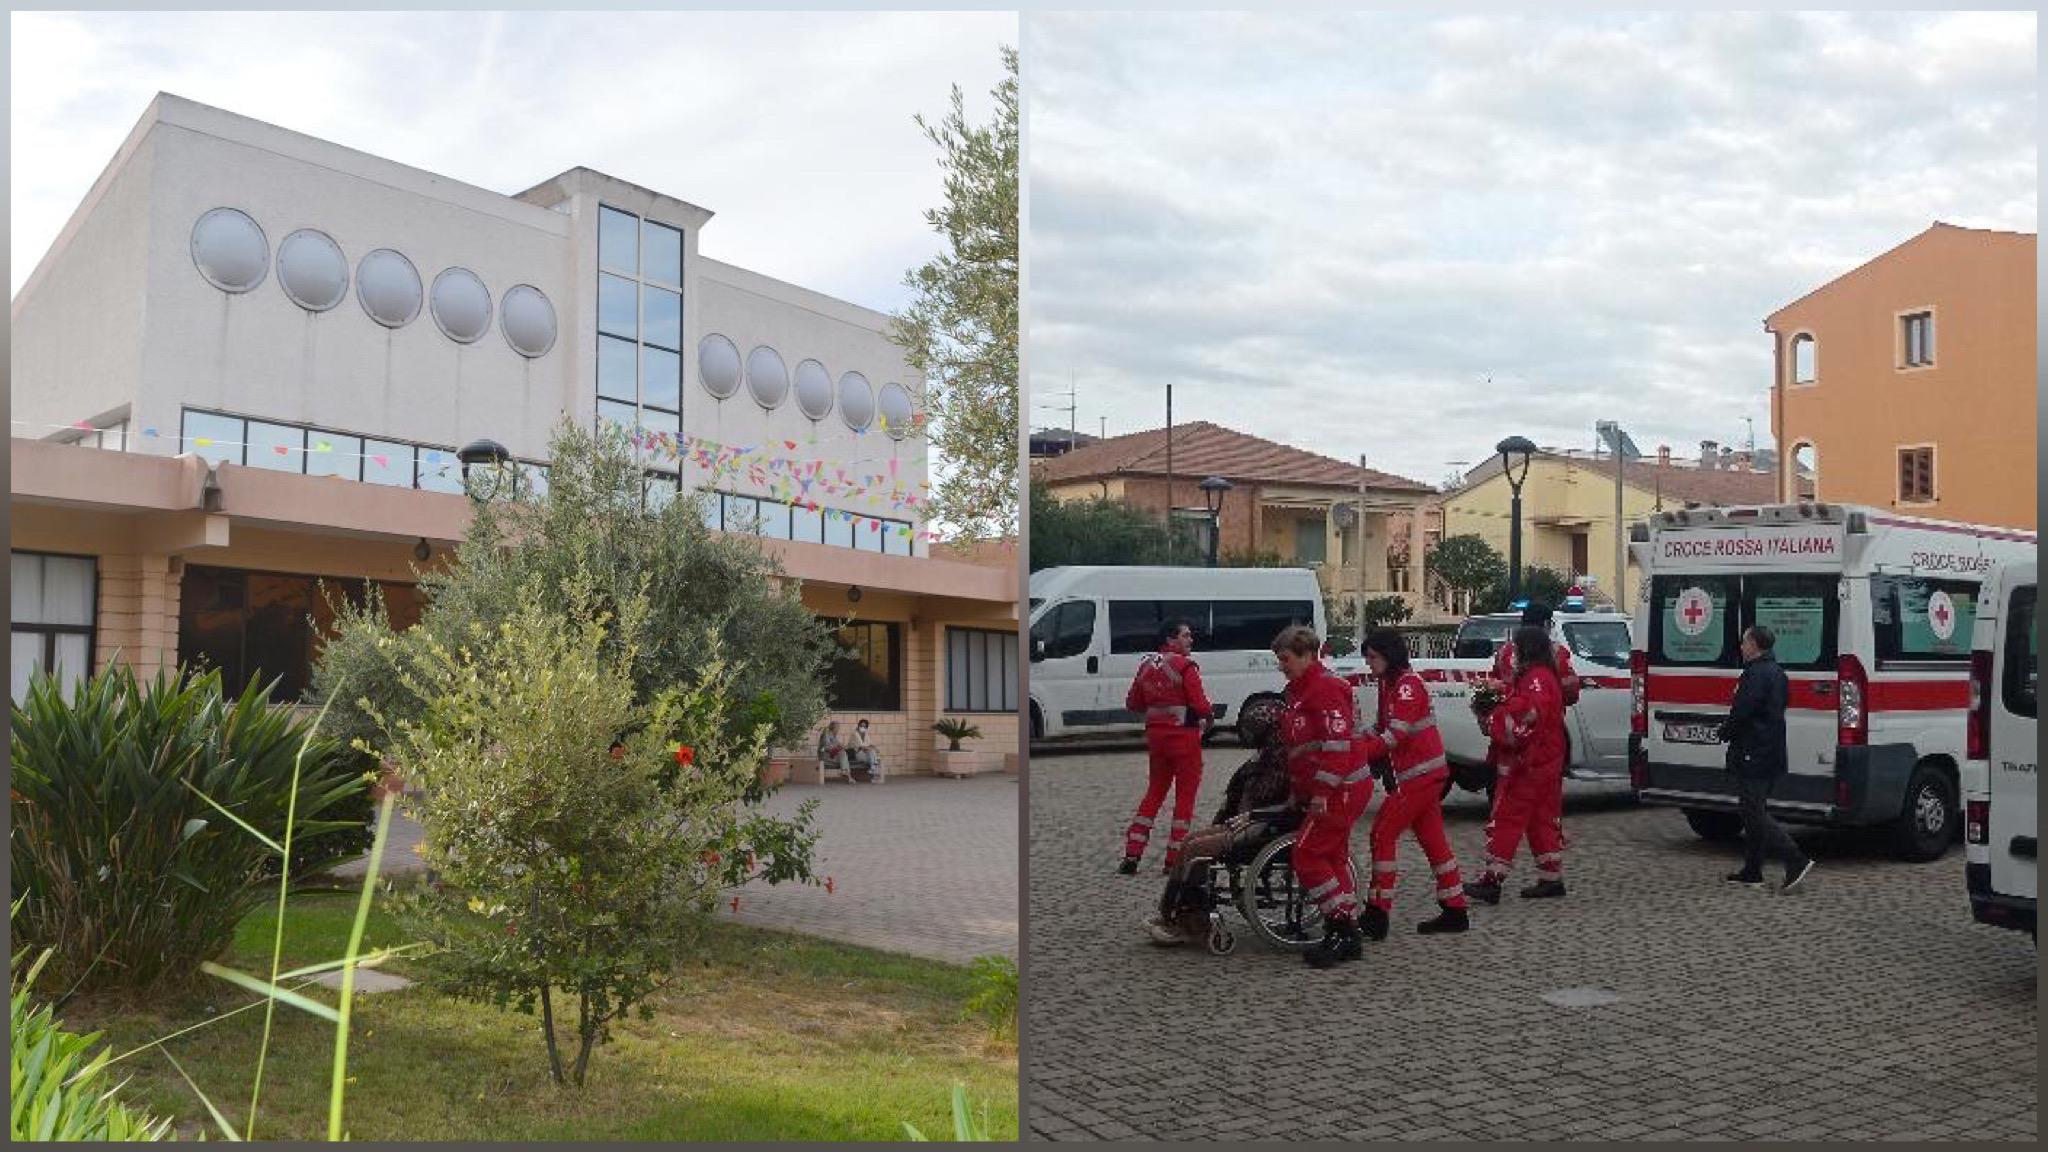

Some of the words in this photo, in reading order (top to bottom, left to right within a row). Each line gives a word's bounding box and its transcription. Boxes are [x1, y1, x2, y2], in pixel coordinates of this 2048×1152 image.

[1664, 541, 1711, 558] CROCE
[1714, 539, 1763, 556] ROSSA
[1768, 537, 1834, 555] ITALIANA
[1911, 552, 1955, 568] CROCE
